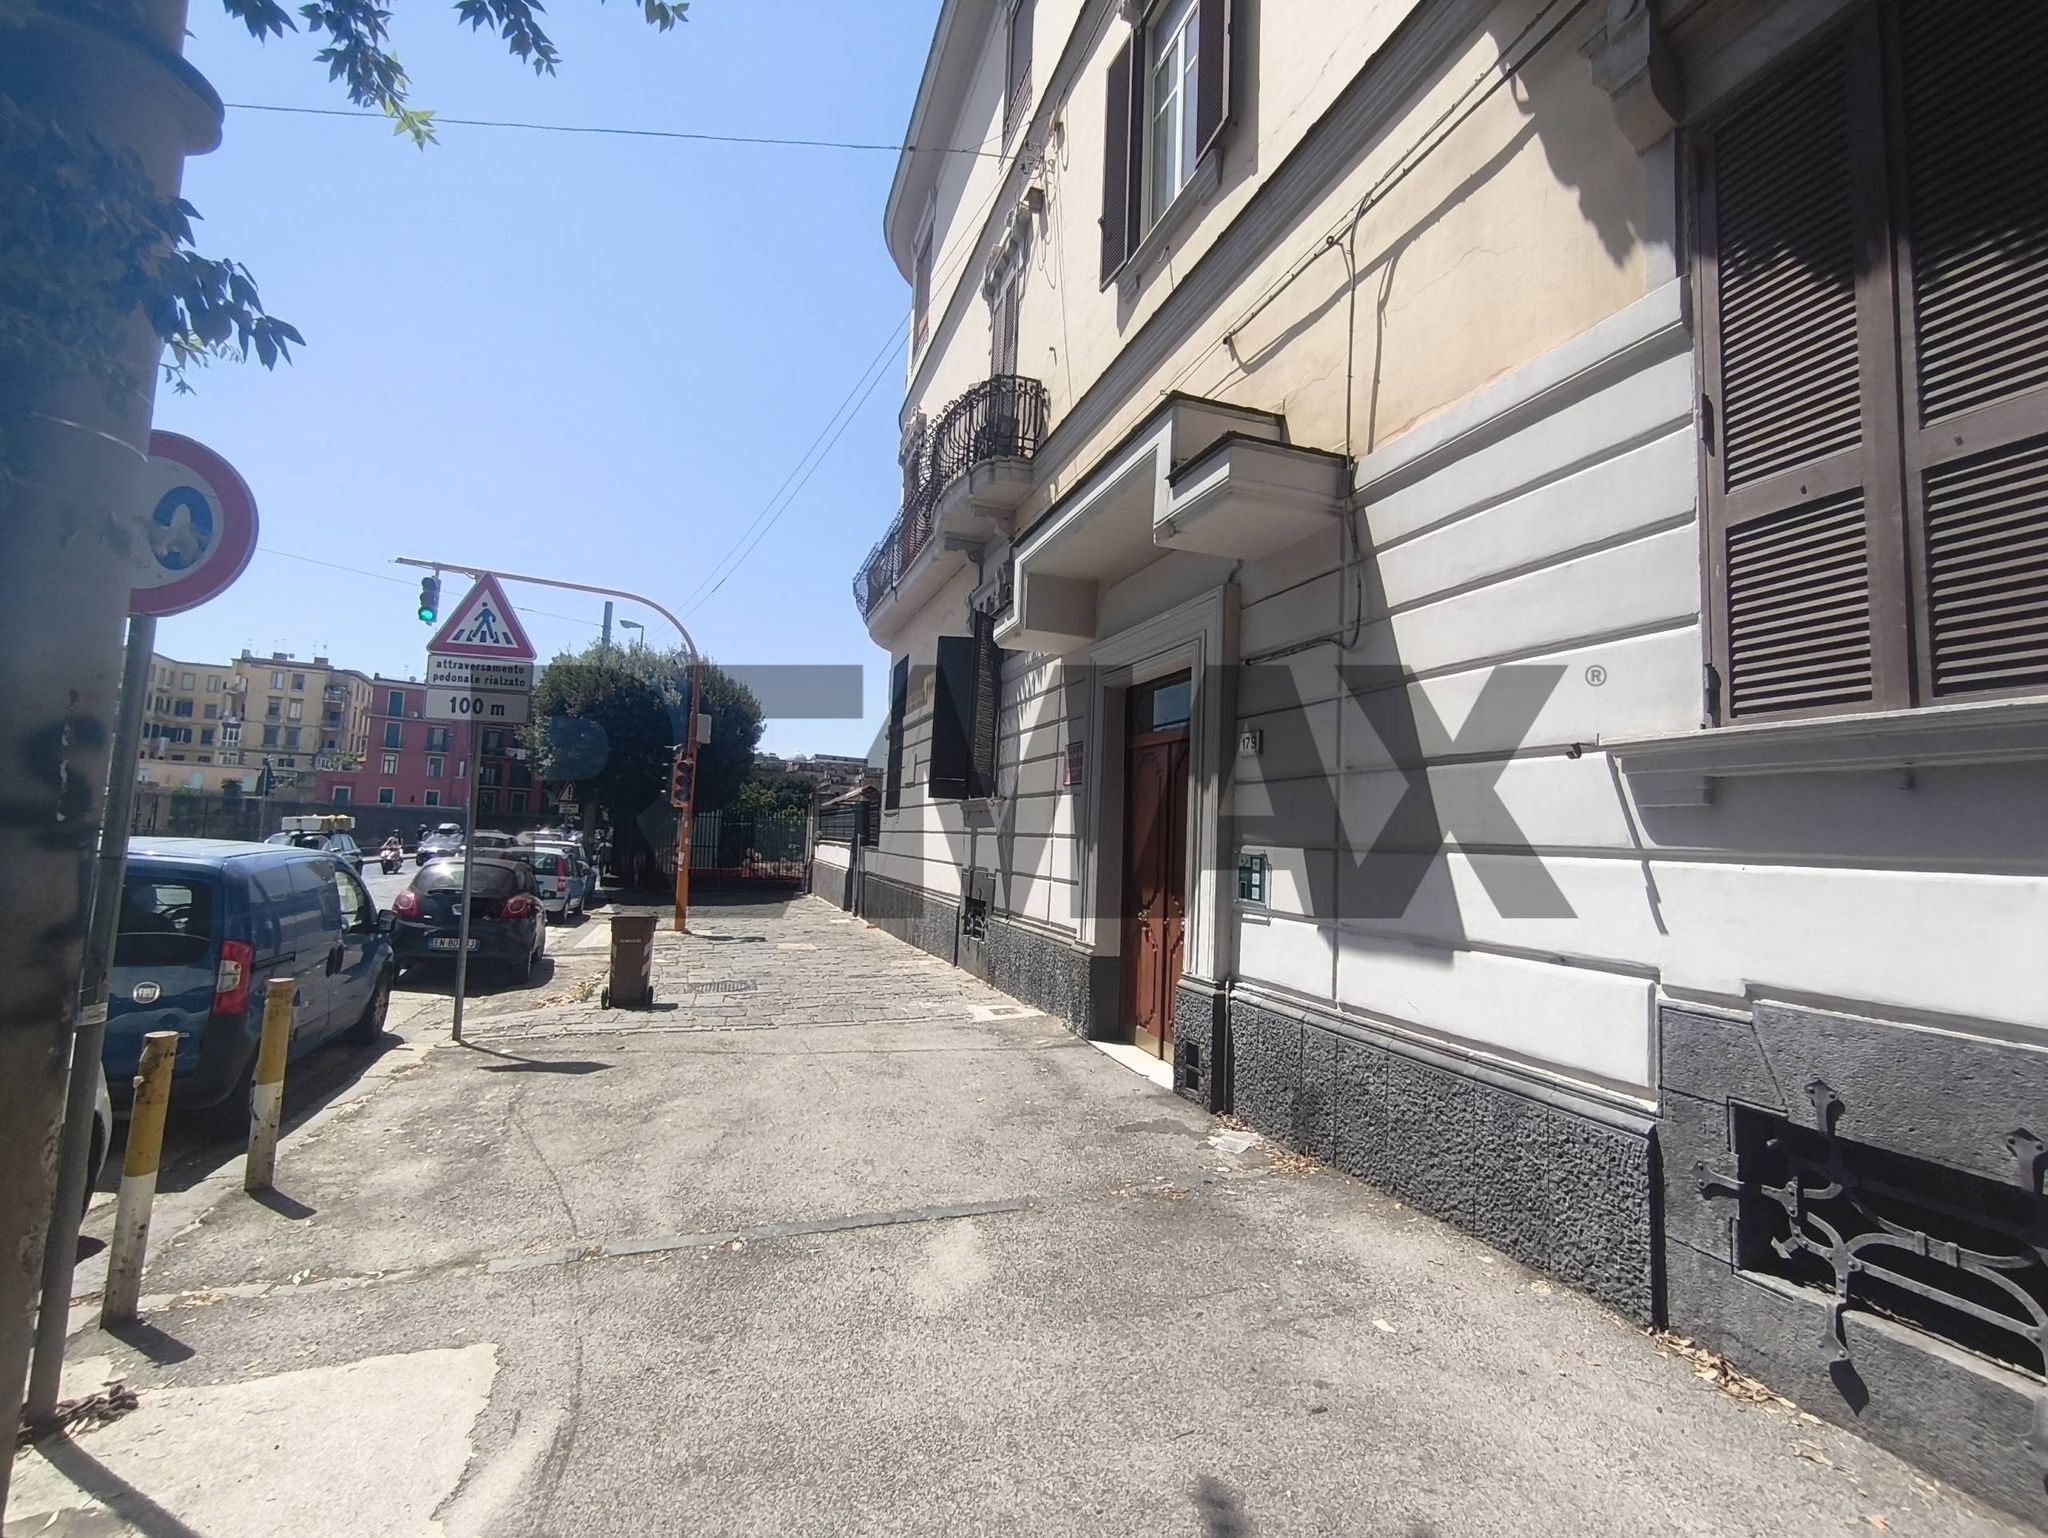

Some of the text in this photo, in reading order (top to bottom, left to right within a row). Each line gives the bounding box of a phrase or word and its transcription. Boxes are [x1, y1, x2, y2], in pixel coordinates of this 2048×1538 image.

[436, 659, 525, 674] attraversamento
[433, 672, 526, 687] pedonale rialzato
[450, 696, 505, 716] 100 m
[1242, 736, 1257, 750] 179
